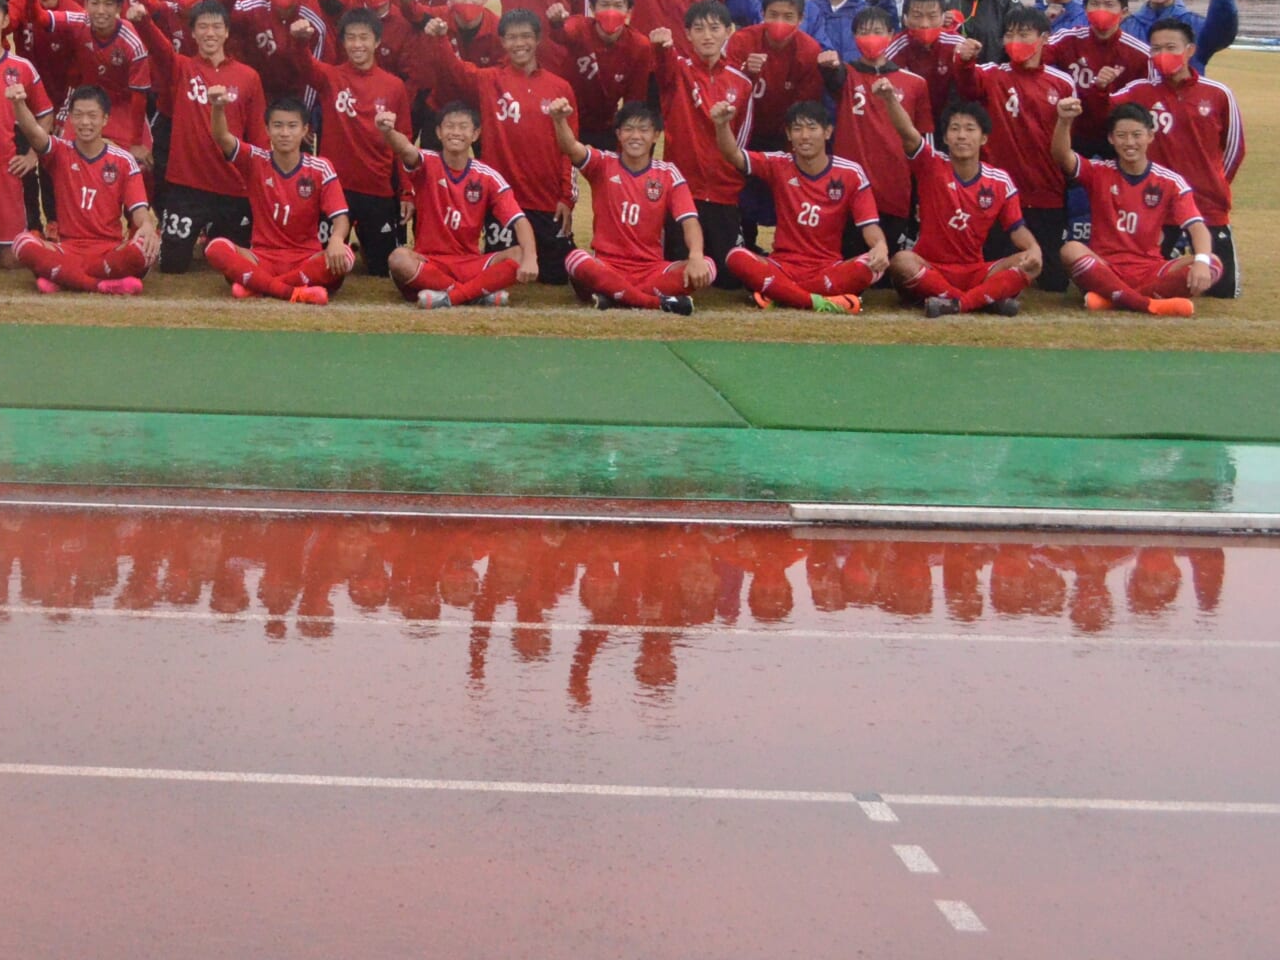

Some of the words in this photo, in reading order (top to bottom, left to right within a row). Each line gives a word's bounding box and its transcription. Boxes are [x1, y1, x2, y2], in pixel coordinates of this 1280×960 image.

[1069, 63, 1094, 89] 30
[187, 78, 208, 105] 33
[335, 89, 358, 118] 85
[852, 93, 867, 115] 2
[496, 98, 521, 124] 34
[1005, 94, 1019, 118] 4
[80, 185, 97, 210] 17
[167, 213, 193, 239] 33
[273, 202, 291, 226] 11
[444, 205, 461, 231] 18
[621, 200, 640, 226] 10
[797, 201, 820, 227] 26
[1116, 209, 1138, 234] 20
[487, 222, 512, 246] 34
